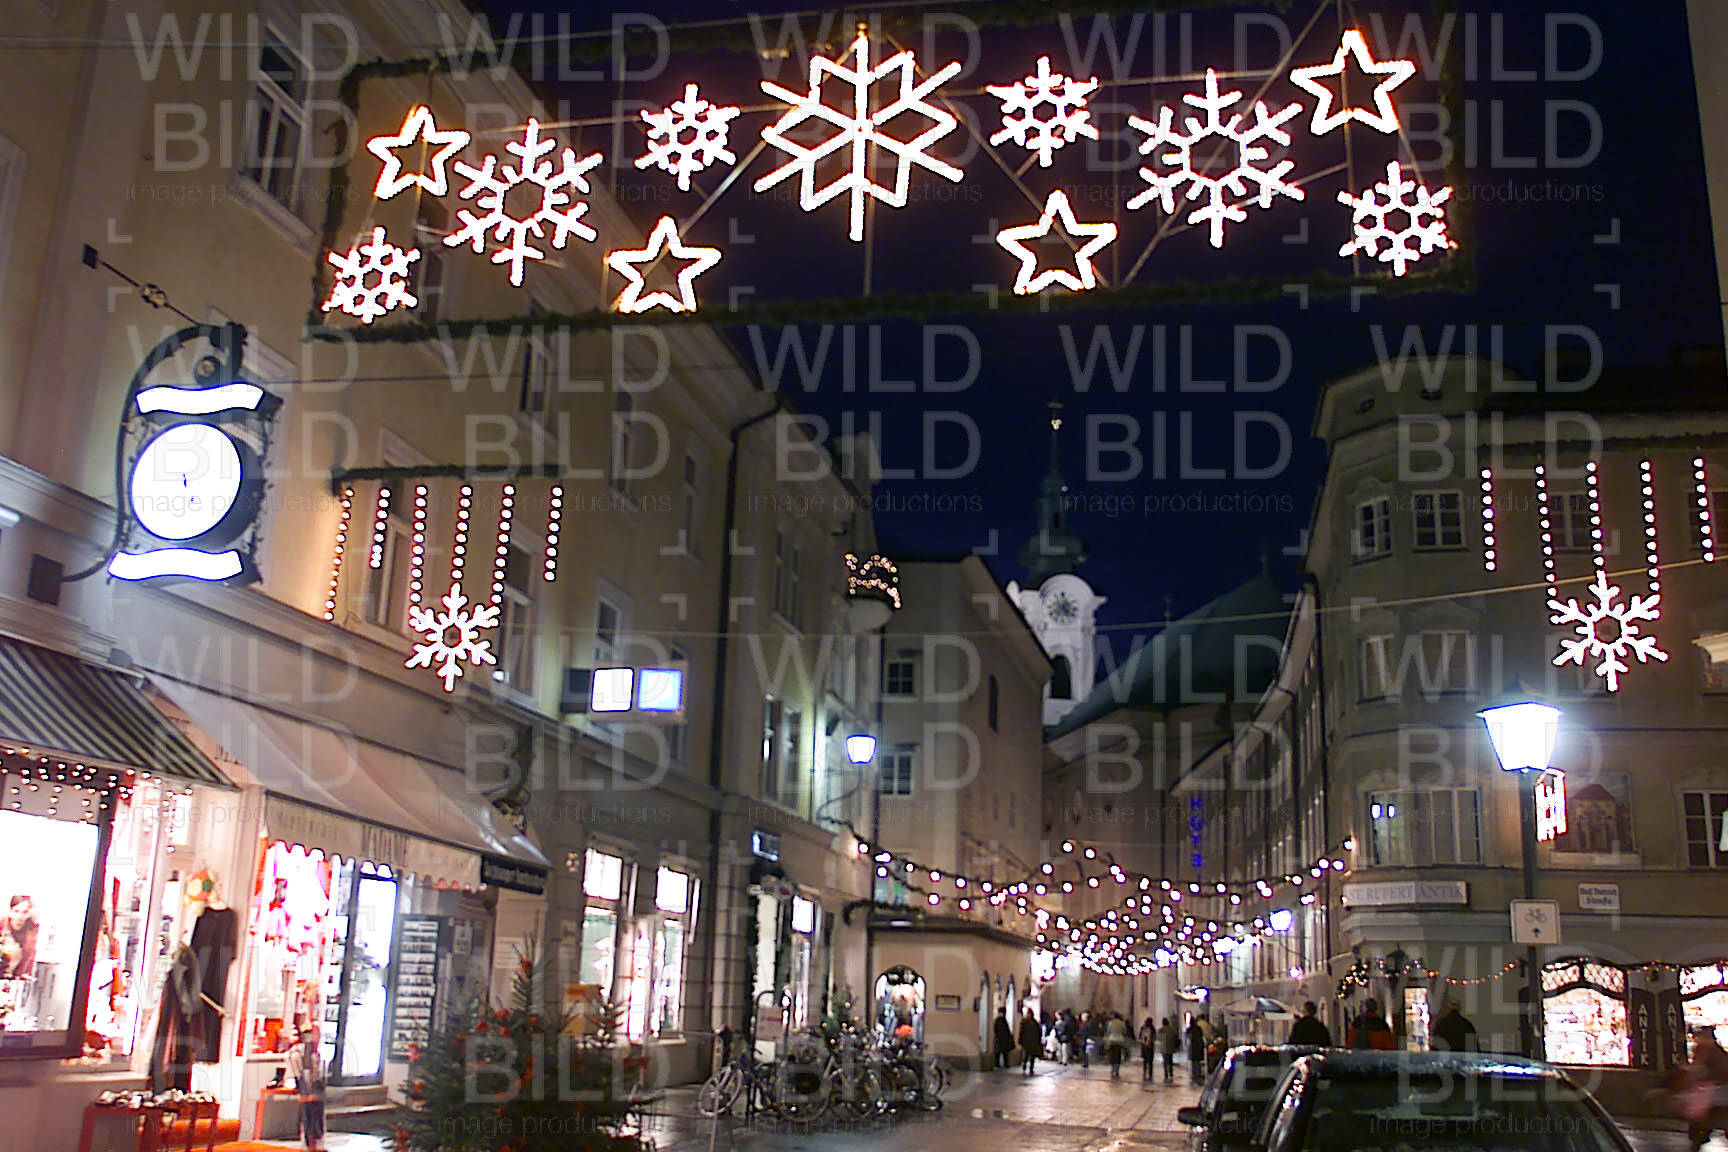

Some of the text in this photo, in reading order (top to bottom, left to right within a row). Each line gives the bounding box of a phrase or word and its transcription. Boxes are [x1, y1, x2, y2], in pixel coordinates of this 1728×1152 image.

[1420, 883, 1465, 898] ANTIK
[1638, 1003, 1648, 1065] ANTIK
[1667, 1003, 1680, 1065] ANTIK
